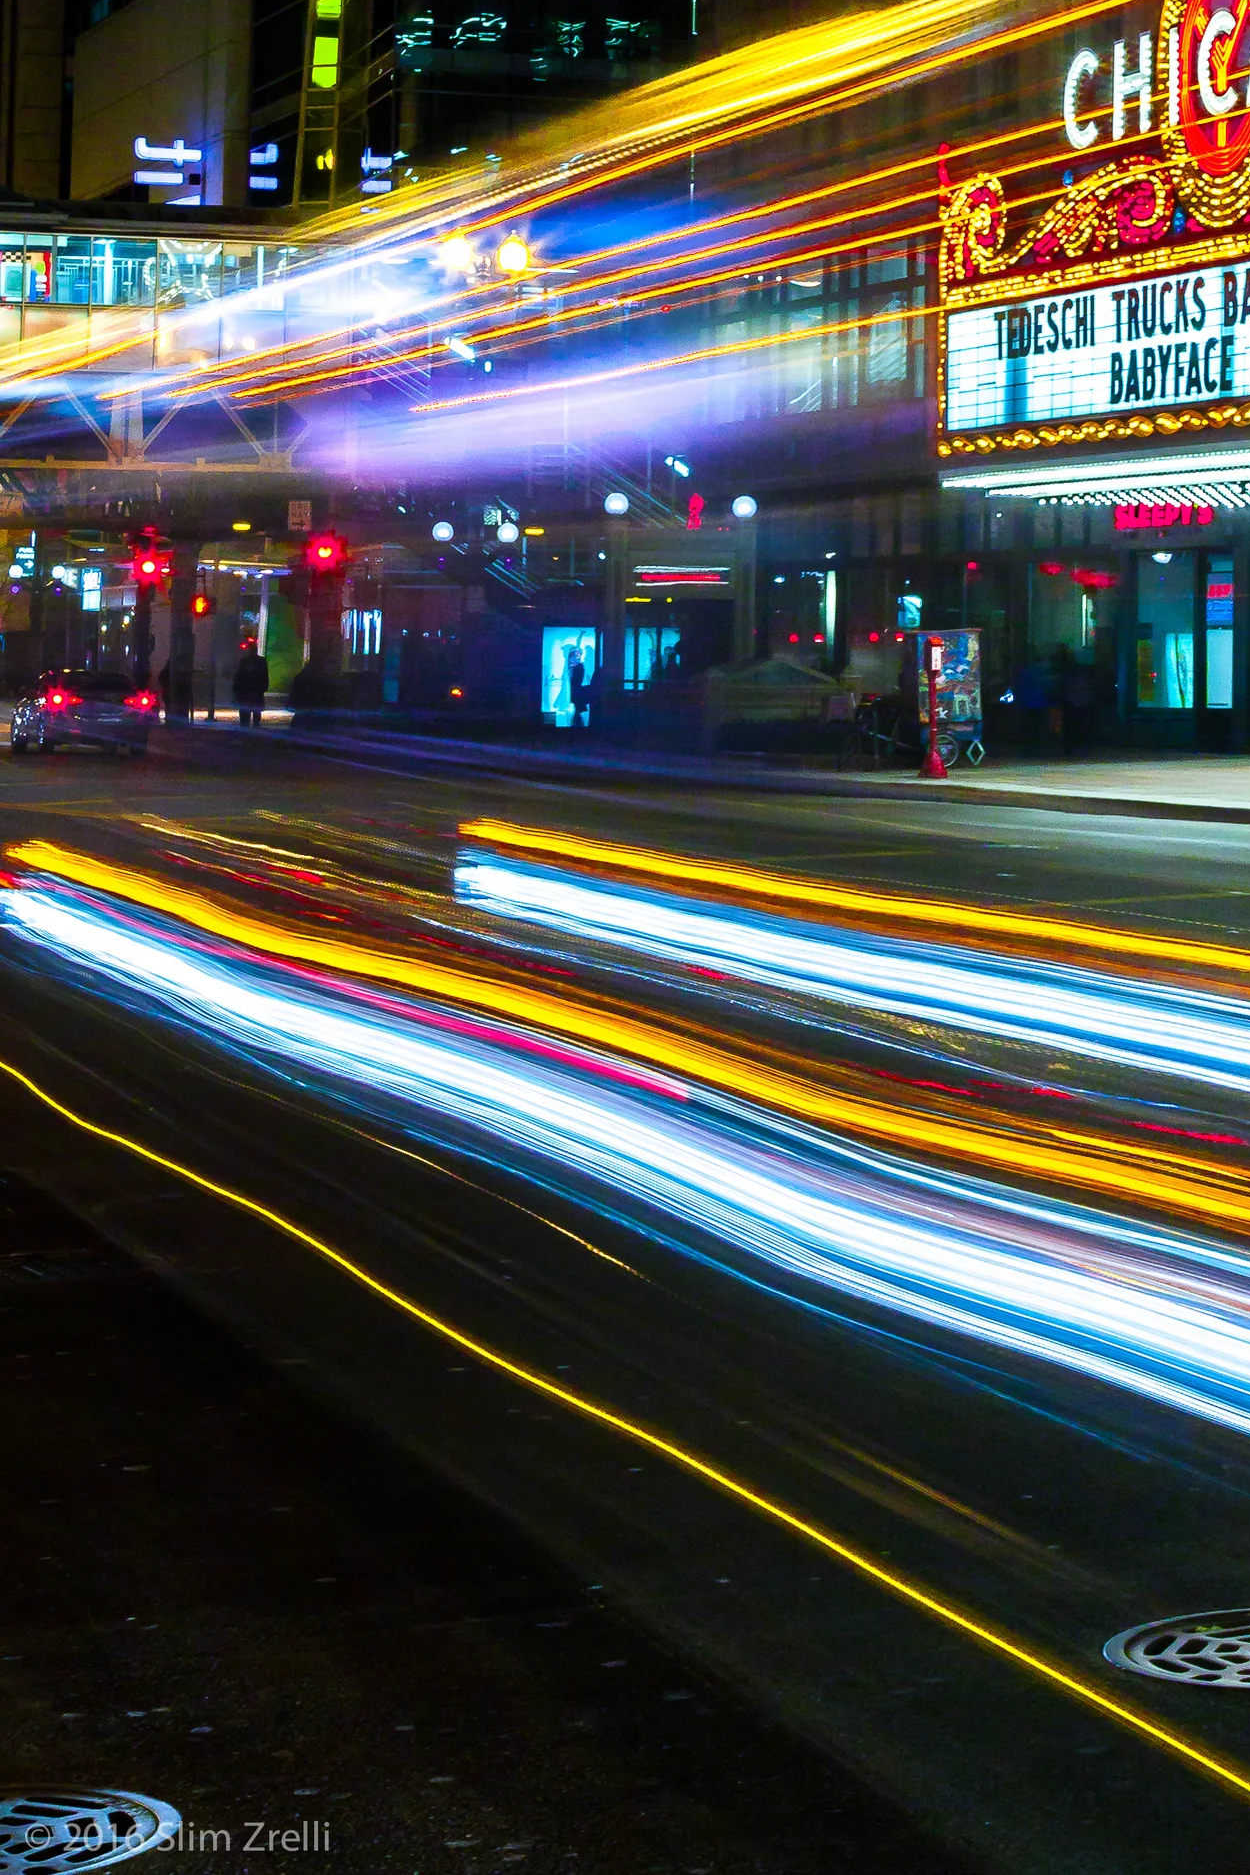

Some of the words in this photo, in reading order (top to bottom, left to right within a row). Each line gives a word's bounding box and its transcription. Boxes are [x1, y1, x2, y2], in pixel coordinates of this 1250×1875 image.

[993, 294, 1096, 361] TEDESCHI
[1111, 276, 1206, 343] TRUCKS
[1110, 334, 1235, 405] BABYFACE
